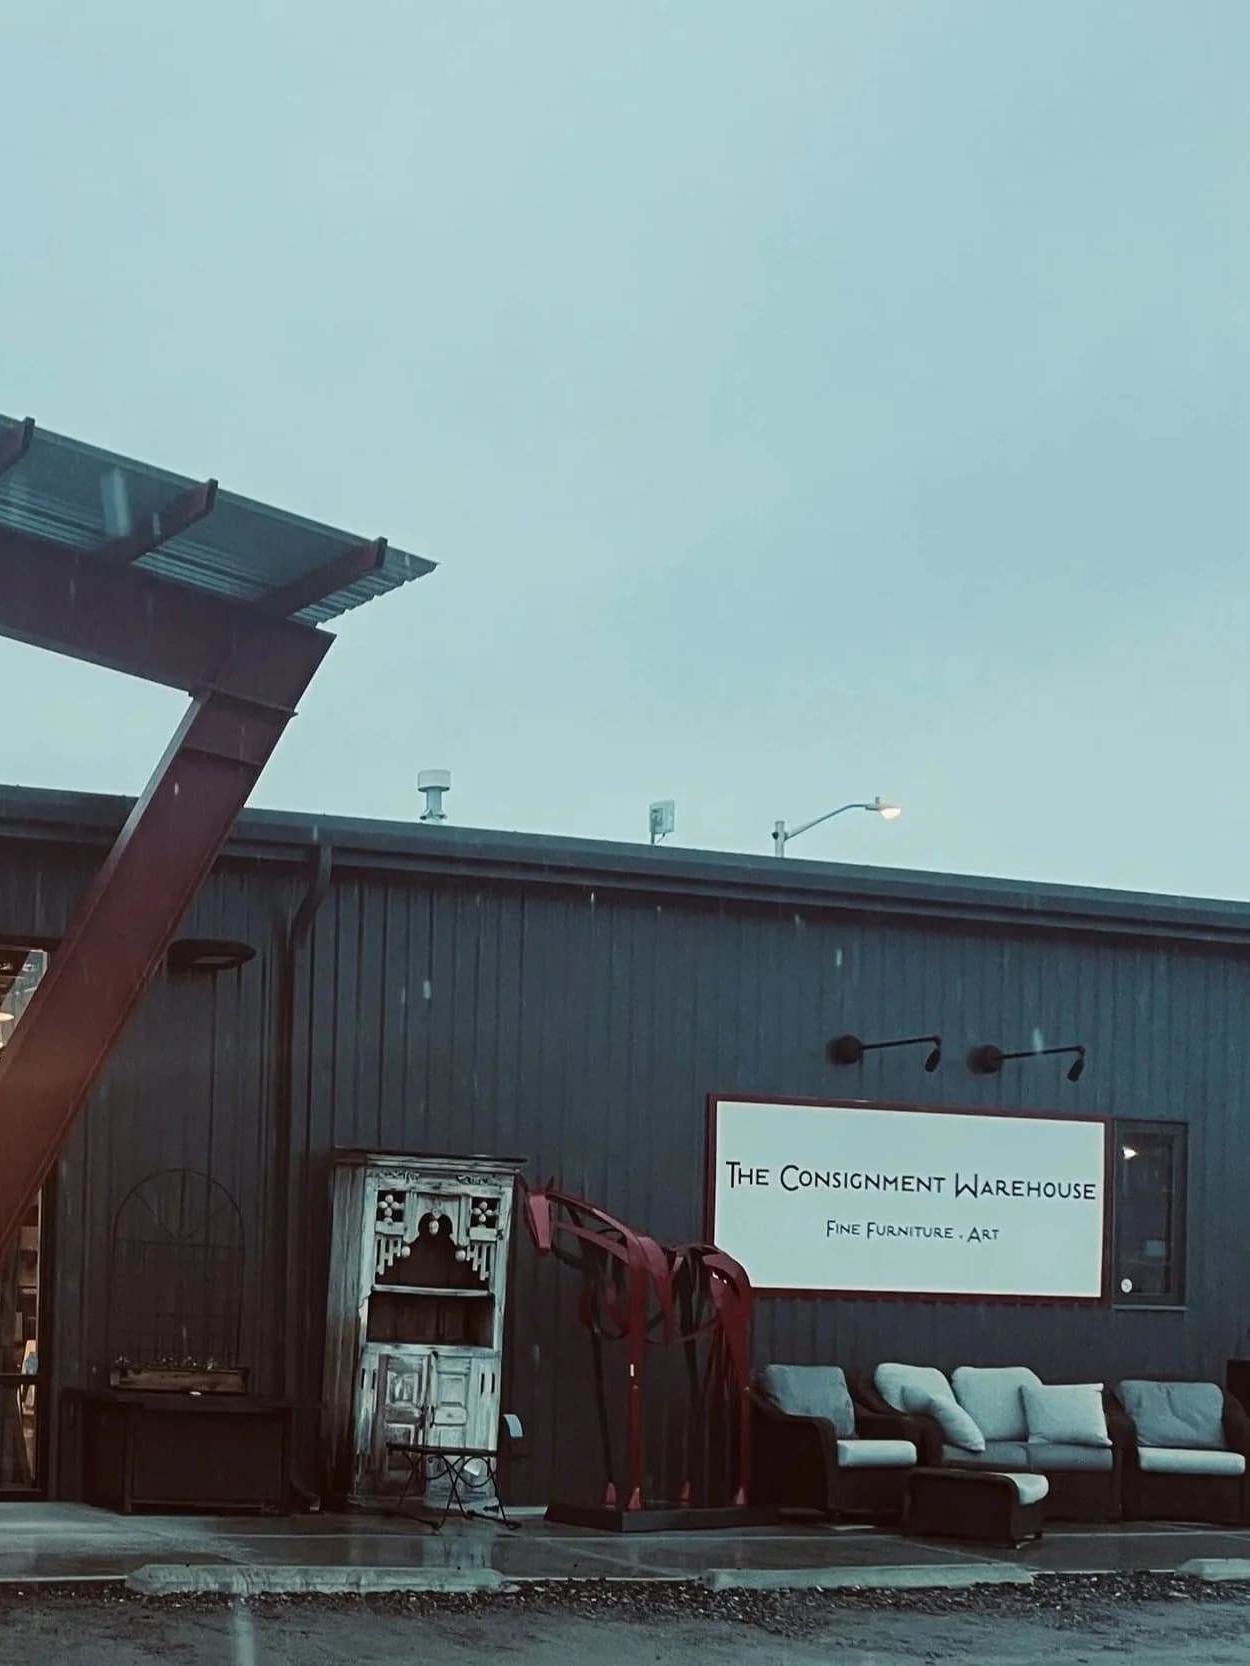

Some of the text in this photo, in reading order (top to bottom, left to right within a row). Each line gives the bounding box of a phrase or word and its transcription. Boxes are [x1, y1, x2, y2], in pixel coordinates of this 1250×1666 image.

[726, 1161, 1096, 1200] THE CONSIGNMENT WAREHOUSE
[827, 1220, 861, 1237] FINE
[867, 1222, 954, 1239] FURNITURE
[966, 1227, 999, 1242] ART
